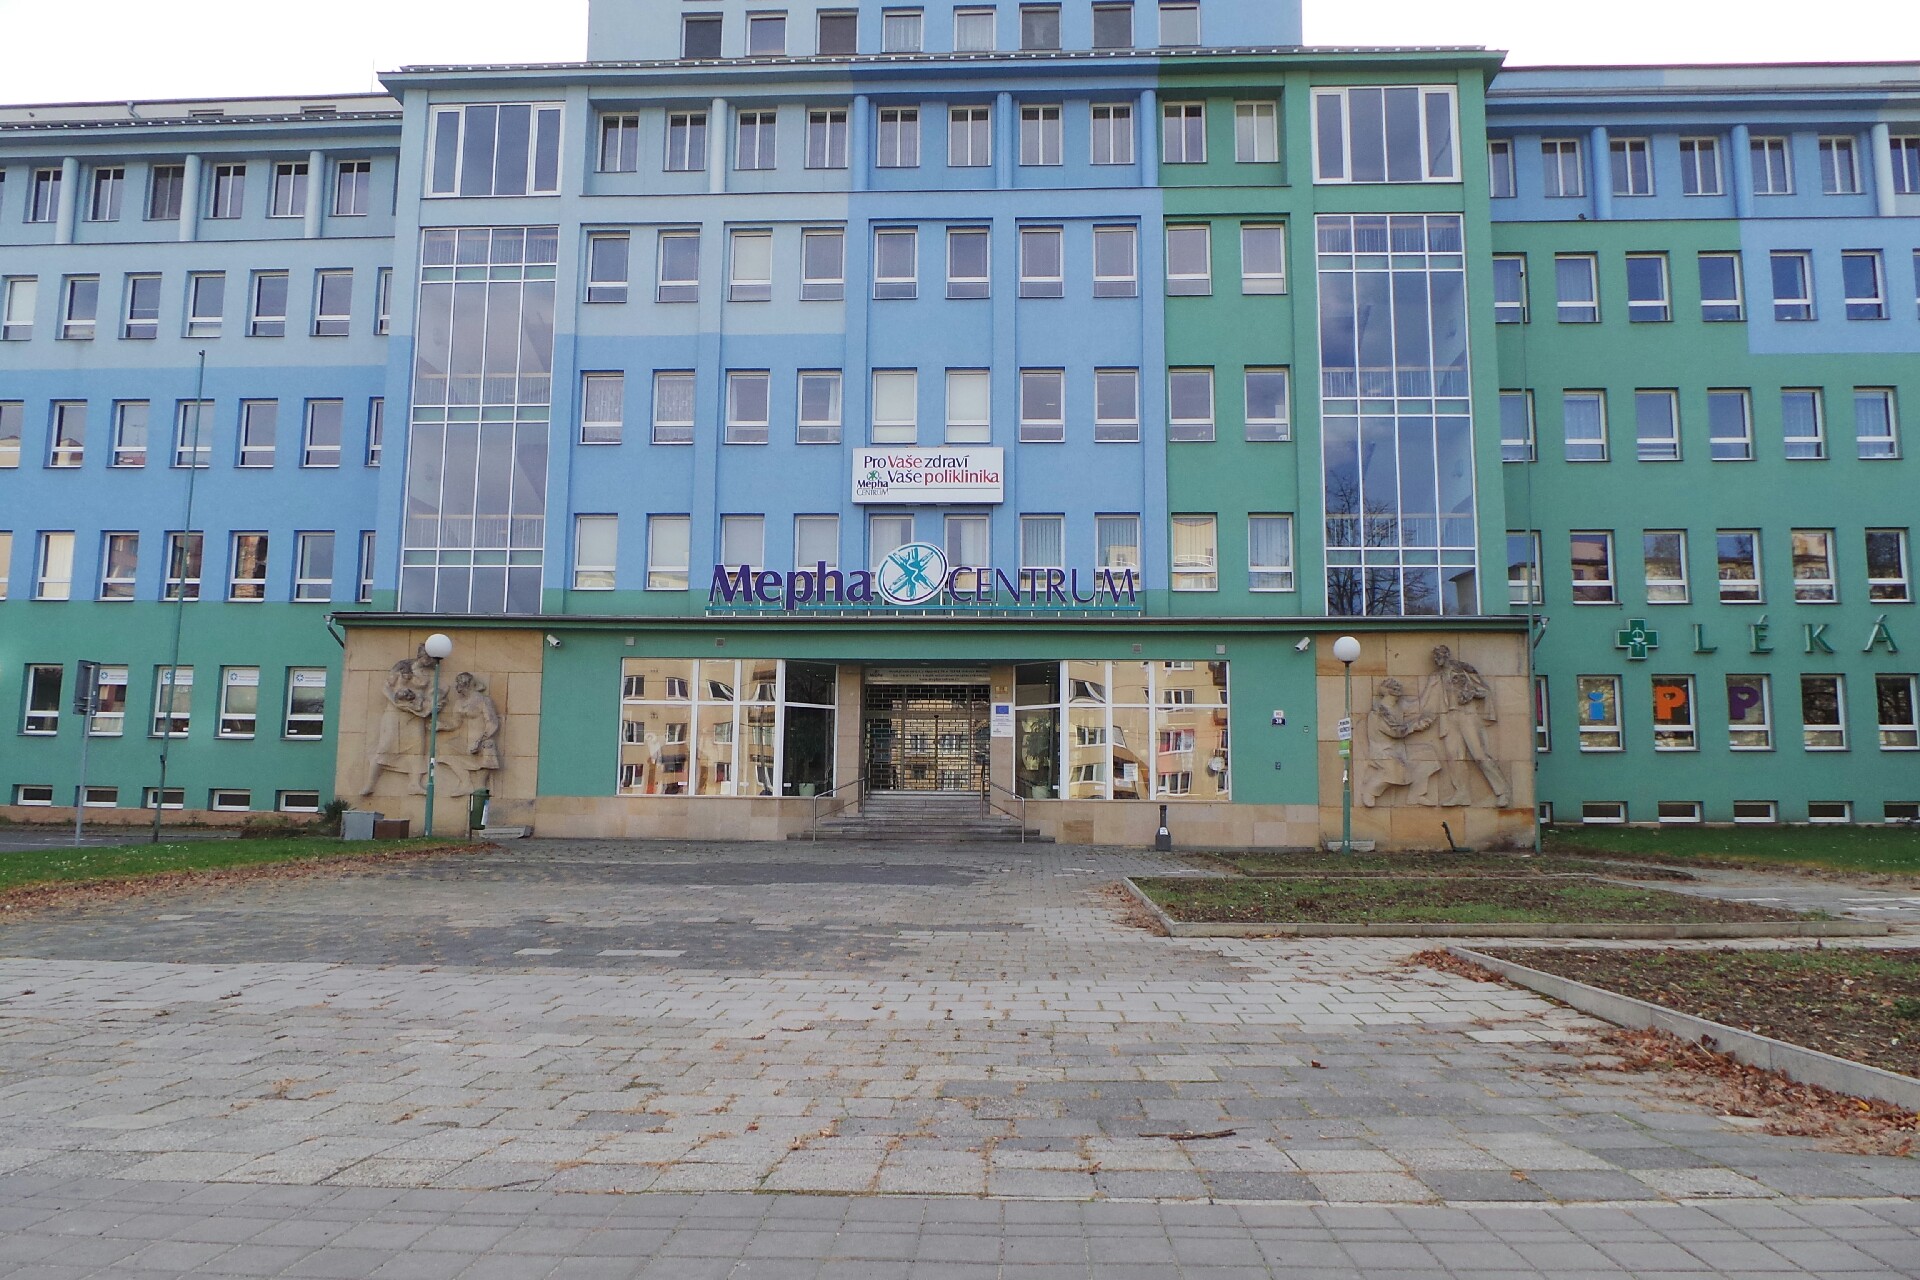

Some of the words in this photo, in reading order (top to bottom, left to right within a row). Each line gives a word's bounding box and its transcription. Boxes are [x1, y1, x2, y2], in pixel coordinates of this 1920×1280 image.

[864, 455, 887, 469] Pro
[888, 454, 923, 469] Vaše
[924, 454, 970, 469] zdraví
[856, 479, 889, 490] Mepha
[887, 469, 923, 484] Vaše
[924, 469, 1000, 486] poliklinika
[856, 488, 889, 496] CENTRUM
[708, 560, 875, 611] Mepha
[948, 566, 1136, 604] CENTRUM
